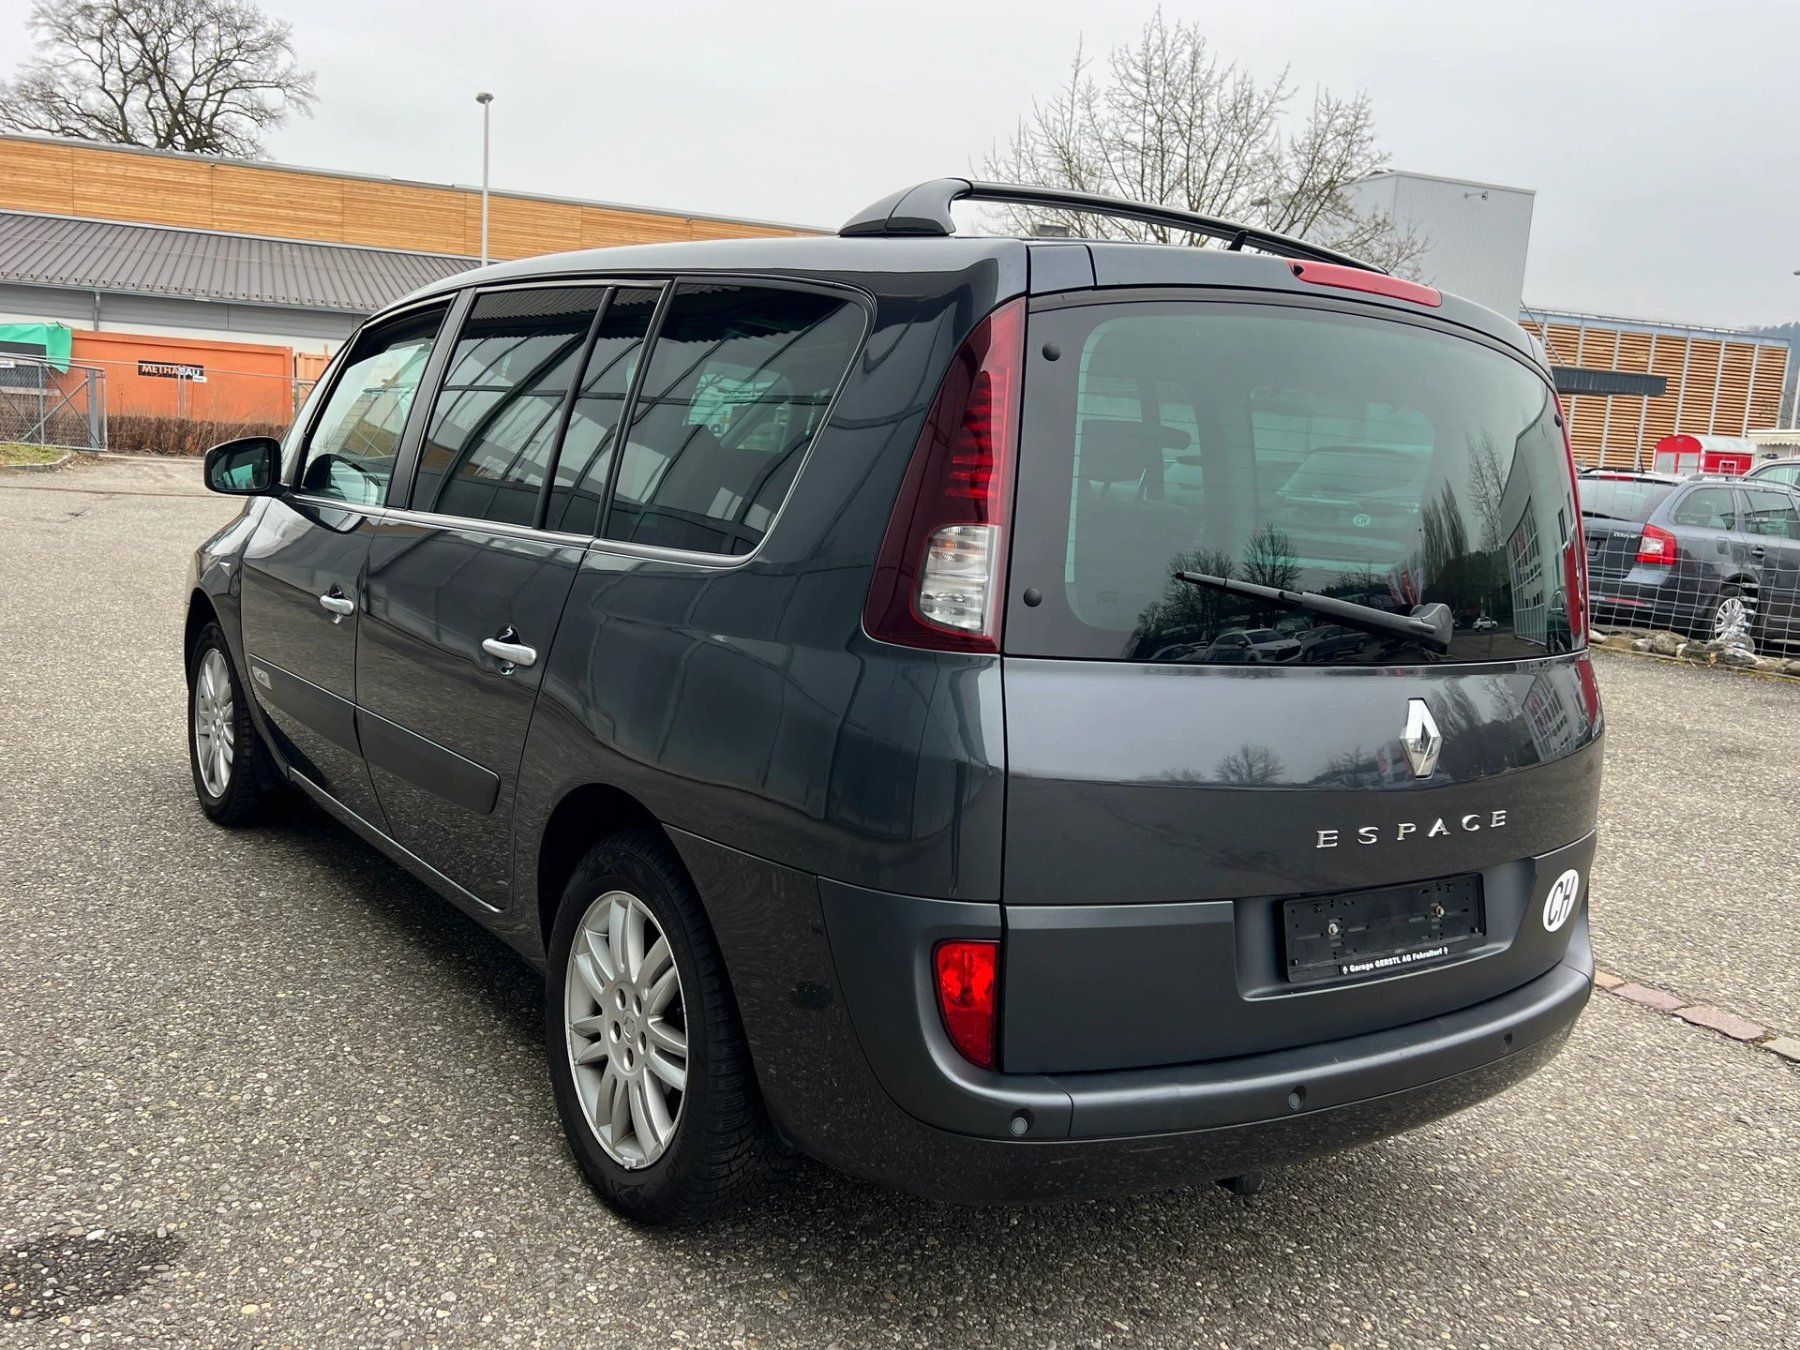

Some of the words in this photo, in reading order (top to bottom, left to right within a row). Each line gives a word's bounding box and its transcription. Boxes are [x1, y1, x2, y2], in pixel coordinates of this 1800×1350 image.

[1315, 810, 1507, 848] ESPACE
[1548, 876, 1575, 926] CH
[1349, 963, 1374, 972] Garage
[1375, 956, 1401, 968] GERSTL
[1402, 954, 1412, 962] AG
